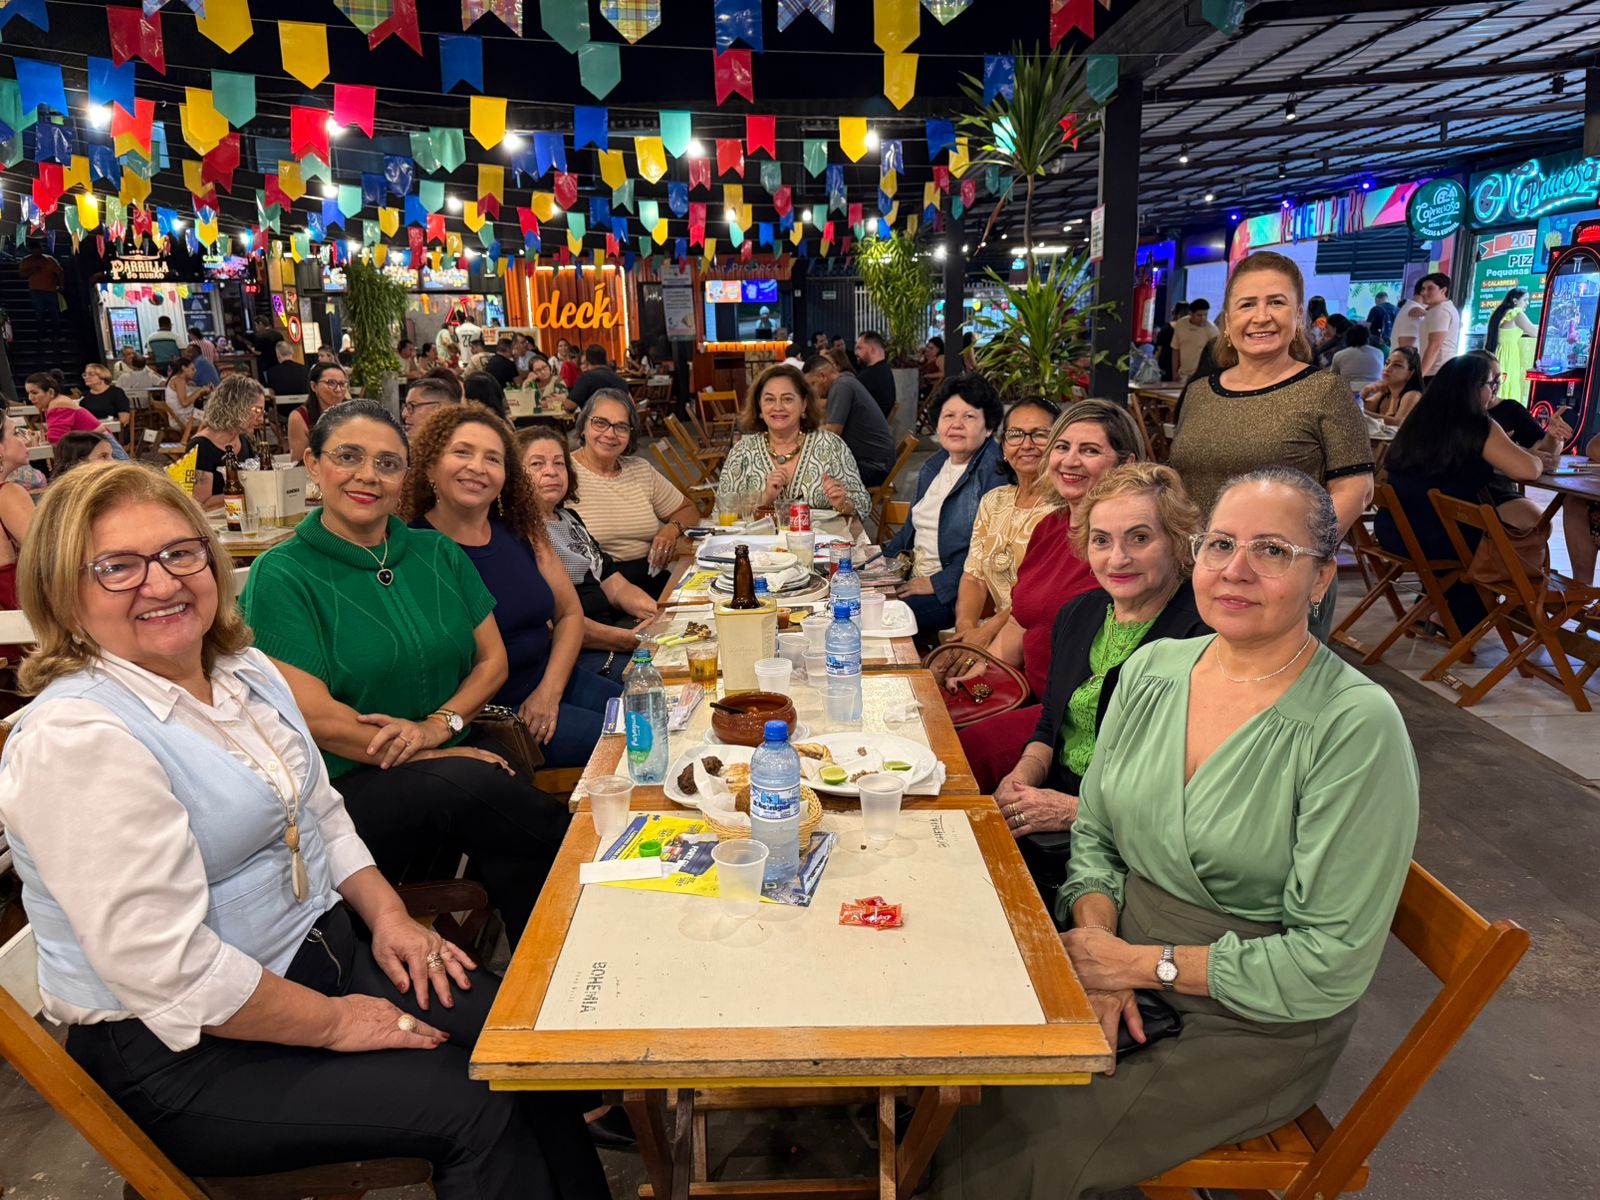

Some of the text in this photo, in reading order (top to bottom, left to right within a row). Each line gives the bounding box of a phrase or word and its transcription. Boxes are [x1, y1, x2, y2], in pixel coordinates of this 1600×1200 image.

[1280, 189, 1367, 246] RECREIO PARK
[110, 260, 169, 280] PARRILLA
[1486, 268, 1530, 278] Pequenas
[1508, 253, 1533, 267] PIZ
[535, 282, 624, 329] deck
[579, 961, 608, 1013] BOHEMIA
